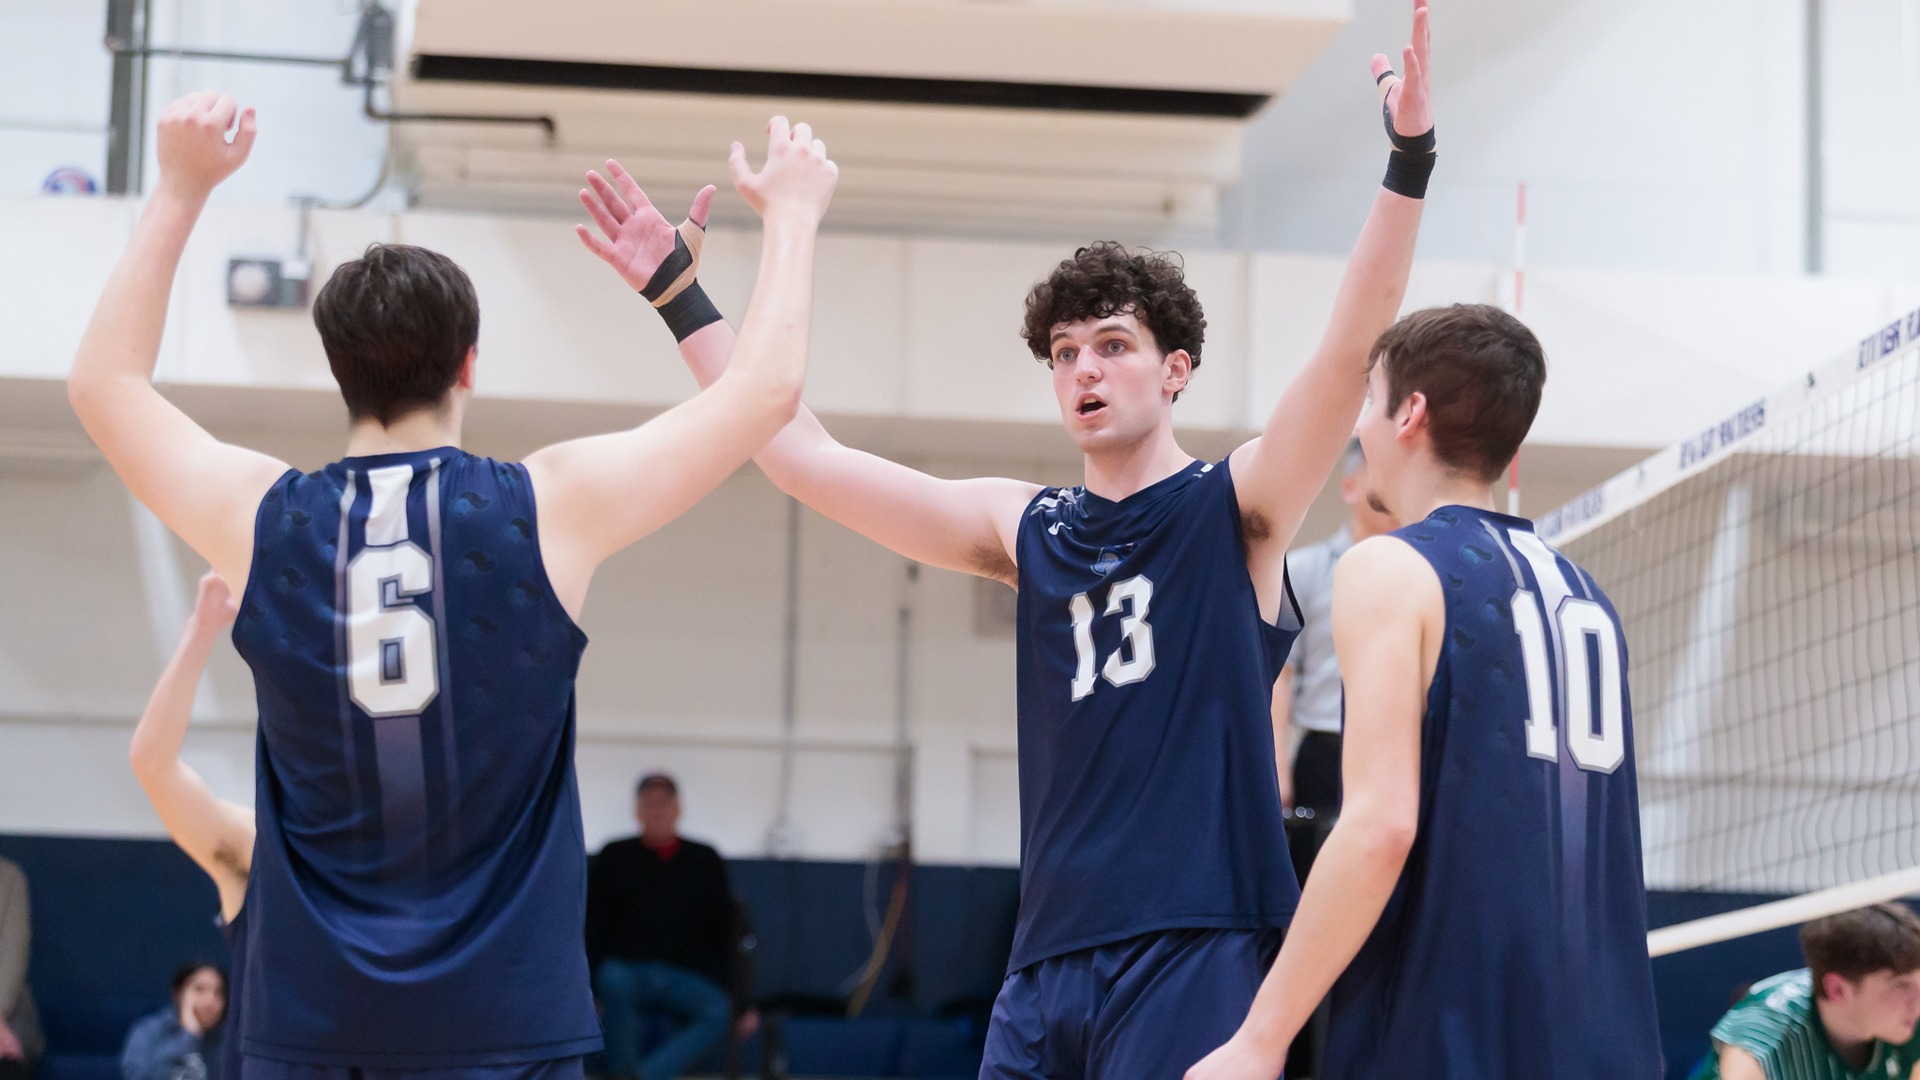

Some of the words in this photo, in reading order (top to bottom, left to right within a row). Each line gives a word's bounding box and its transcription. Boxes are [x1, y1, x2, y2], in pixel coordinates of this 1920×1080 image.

[346, 541, 440, 718] 6
[1068, 573, 1156, 702] 13
[1510, 588, 1625, 774] 10
